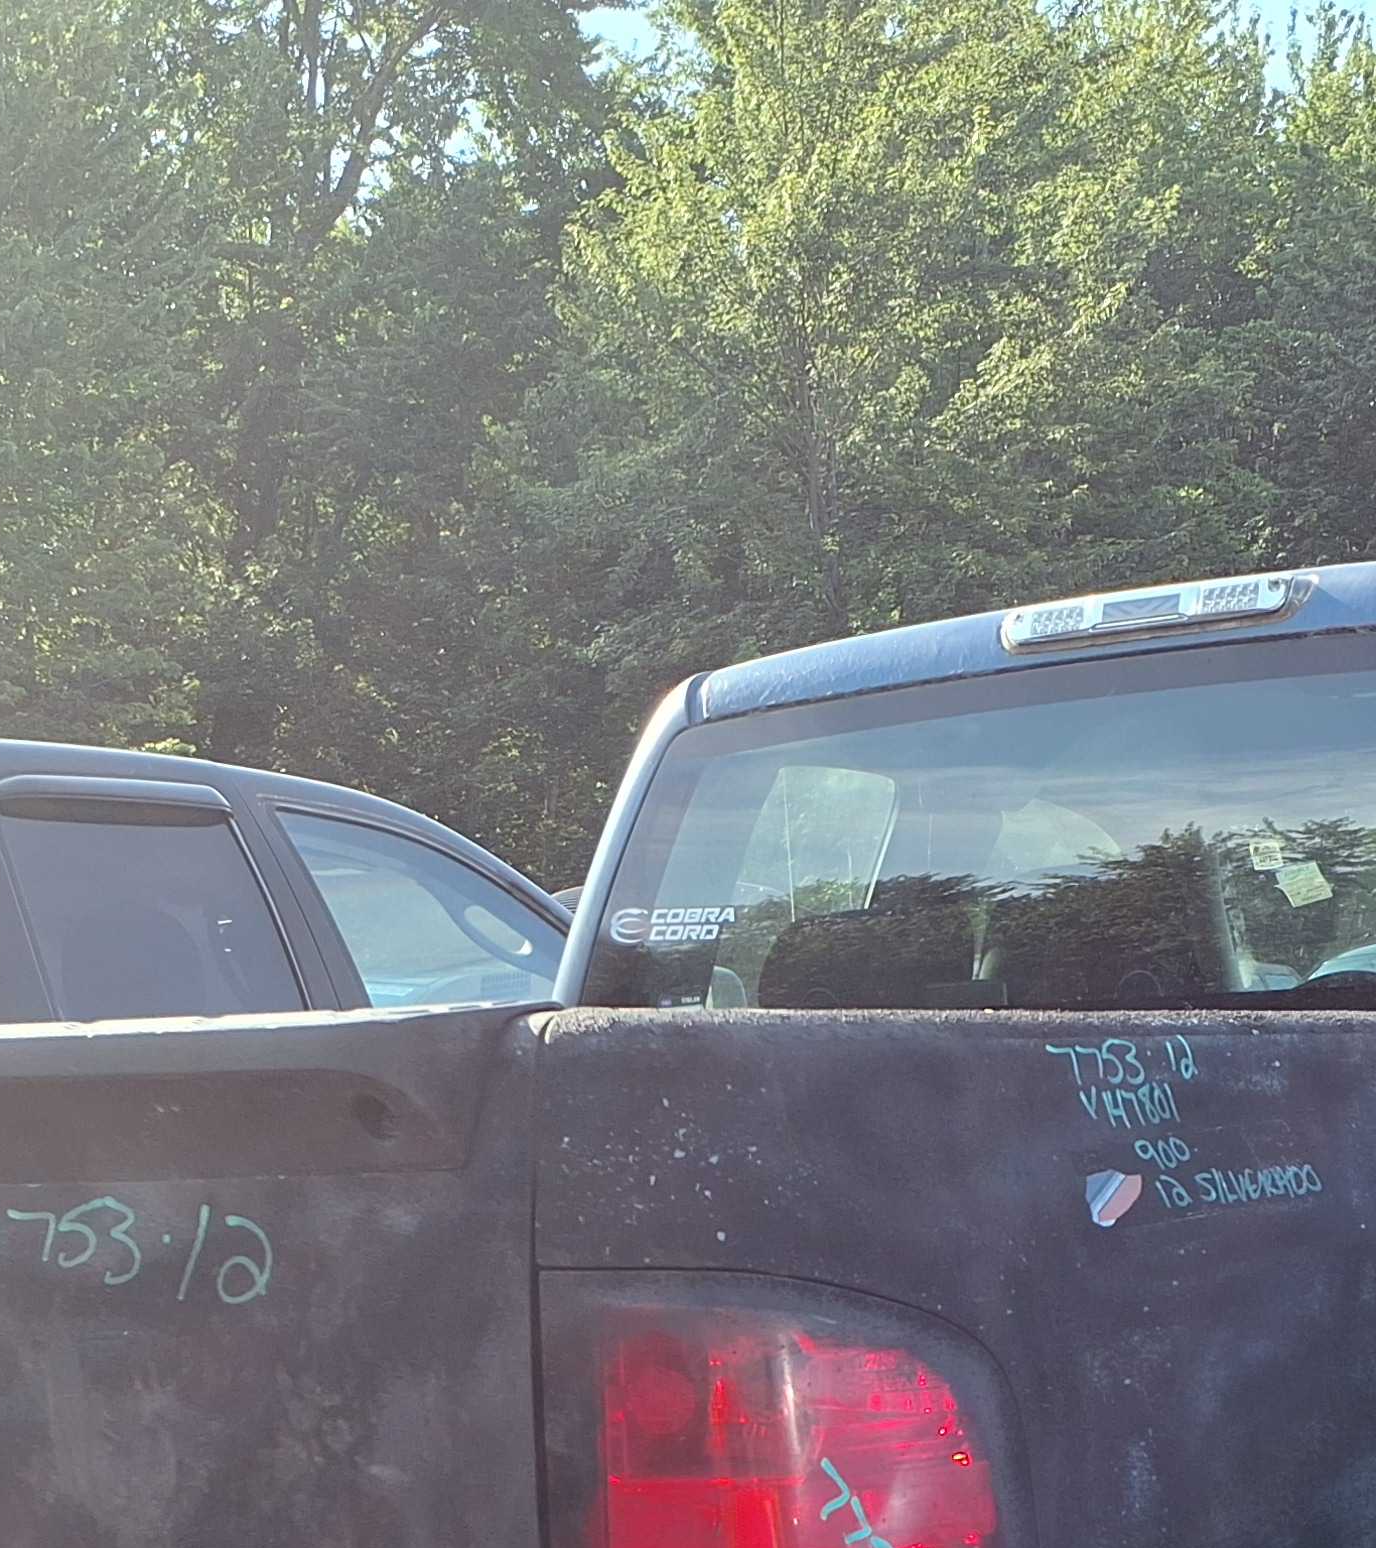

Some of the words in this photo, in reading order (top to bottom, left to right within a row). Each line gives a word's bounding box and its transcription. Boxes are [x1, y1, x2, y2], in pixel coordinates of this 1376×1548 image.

[650, 907, 735, 924] COBRA
[649, 924, 720, 941] CORD
[1134, 1136, 1191, 1170] 900
[1194, 1164, 1323, 1205] SILVERADO
